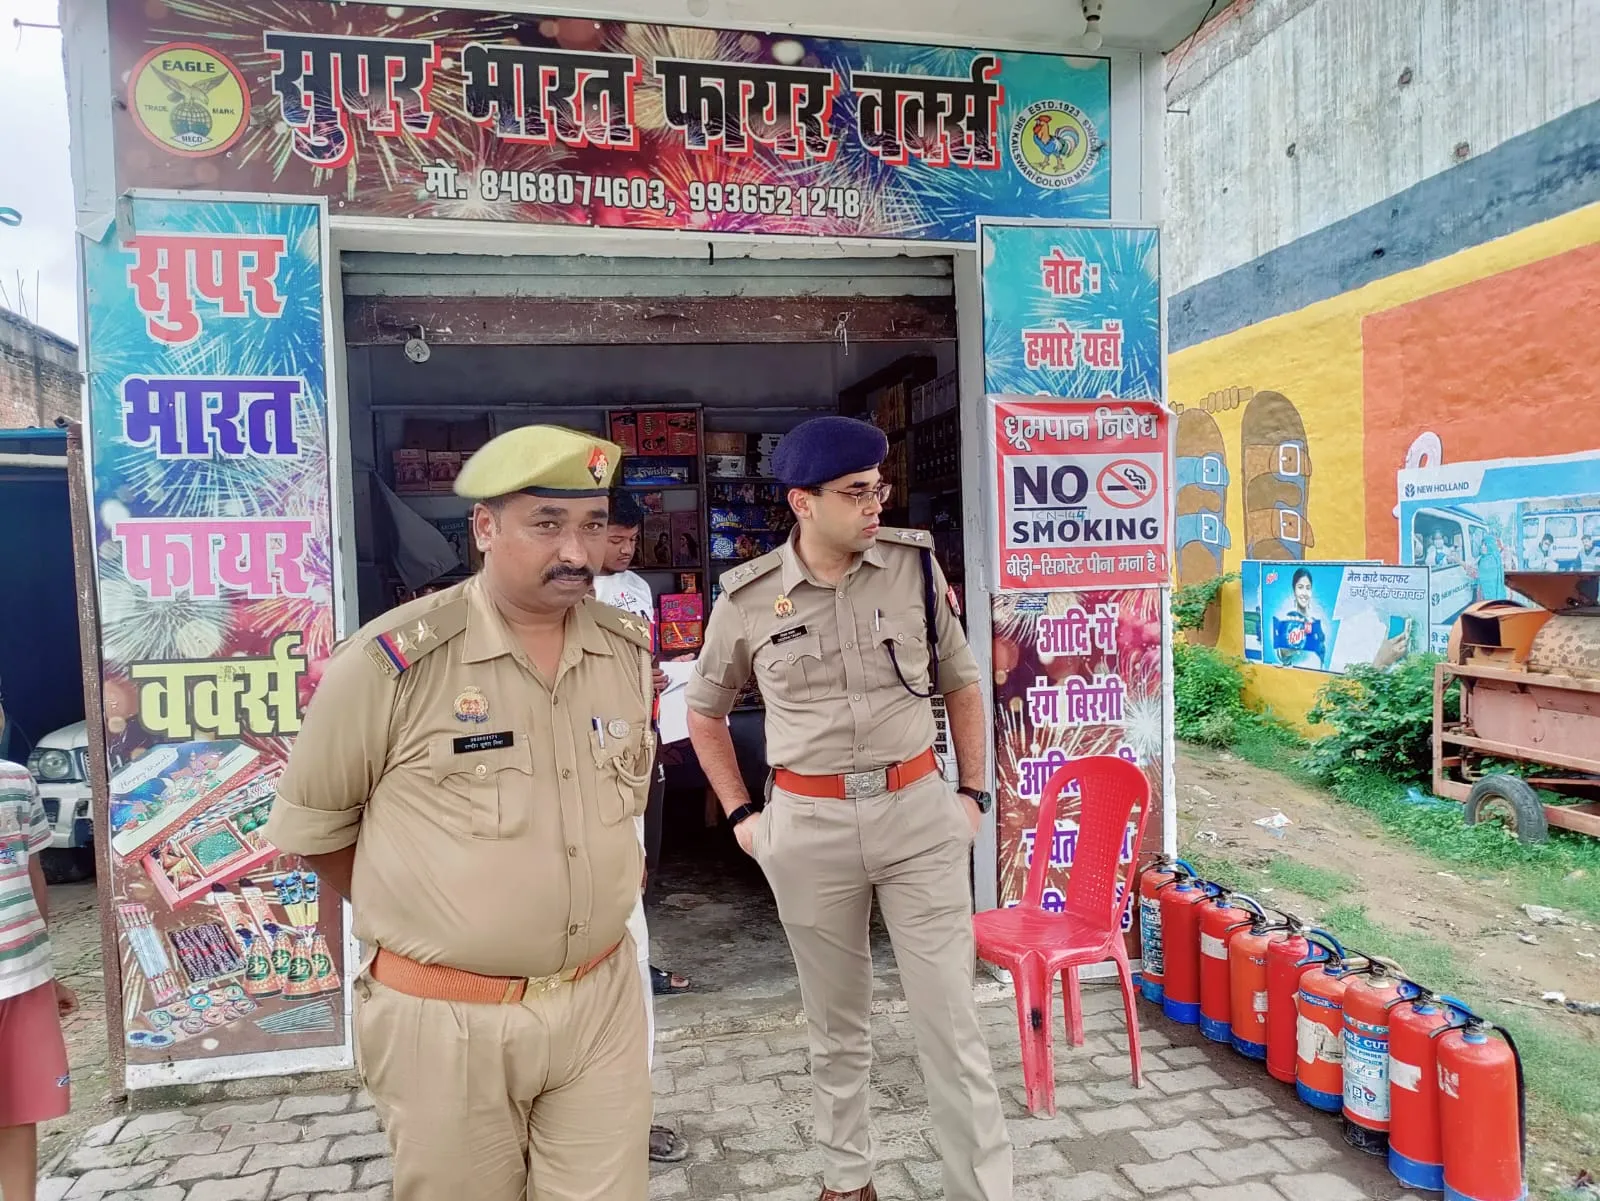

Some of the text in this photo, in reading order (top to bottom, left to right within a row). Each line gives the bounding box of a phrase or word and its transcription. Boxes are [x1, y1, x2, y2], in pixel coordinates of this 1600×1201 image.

[162, 60, 215, 73] EAGLE
[144, 104, 235, 115] TRADE MARK
[264, 30, 1004, 170] सुपर भारत फायर वर्क्स
[1014, 115, 1027, 132] SRI
[1035, 175, 1074, 187] COLOUR
[1073, 153, 1096, 181] MATCH
[421, 159, 861, 219] मो. 8468074603, 9936521248
[122, 231, 287, 345] सुपर
[1024, 321, 1076, 367] हमारे
[121, 375, 305, 460] भारत
[1095, 406, 1159, 440] निषेध
[1013, 465, 1088, 505] NO
[1417, 481, 1469, 494] NEW HOLLAND
[1012, 517, 1159, 544] SMOKING
[111, 517, 316, 602] फायर
[1086, 551, 1115, 574] पीना
[1118, 554, 1144, 572] मना
[1380, 573, 1410, 584] फटाफट
[1039, 604, 1118, 651] आदि में
[129, 631, 307, 741] वर्क्स
[1030, 677, 1124, 724] रंग बिरंगी
[1363, 1039, 1389, 1050] CUT
